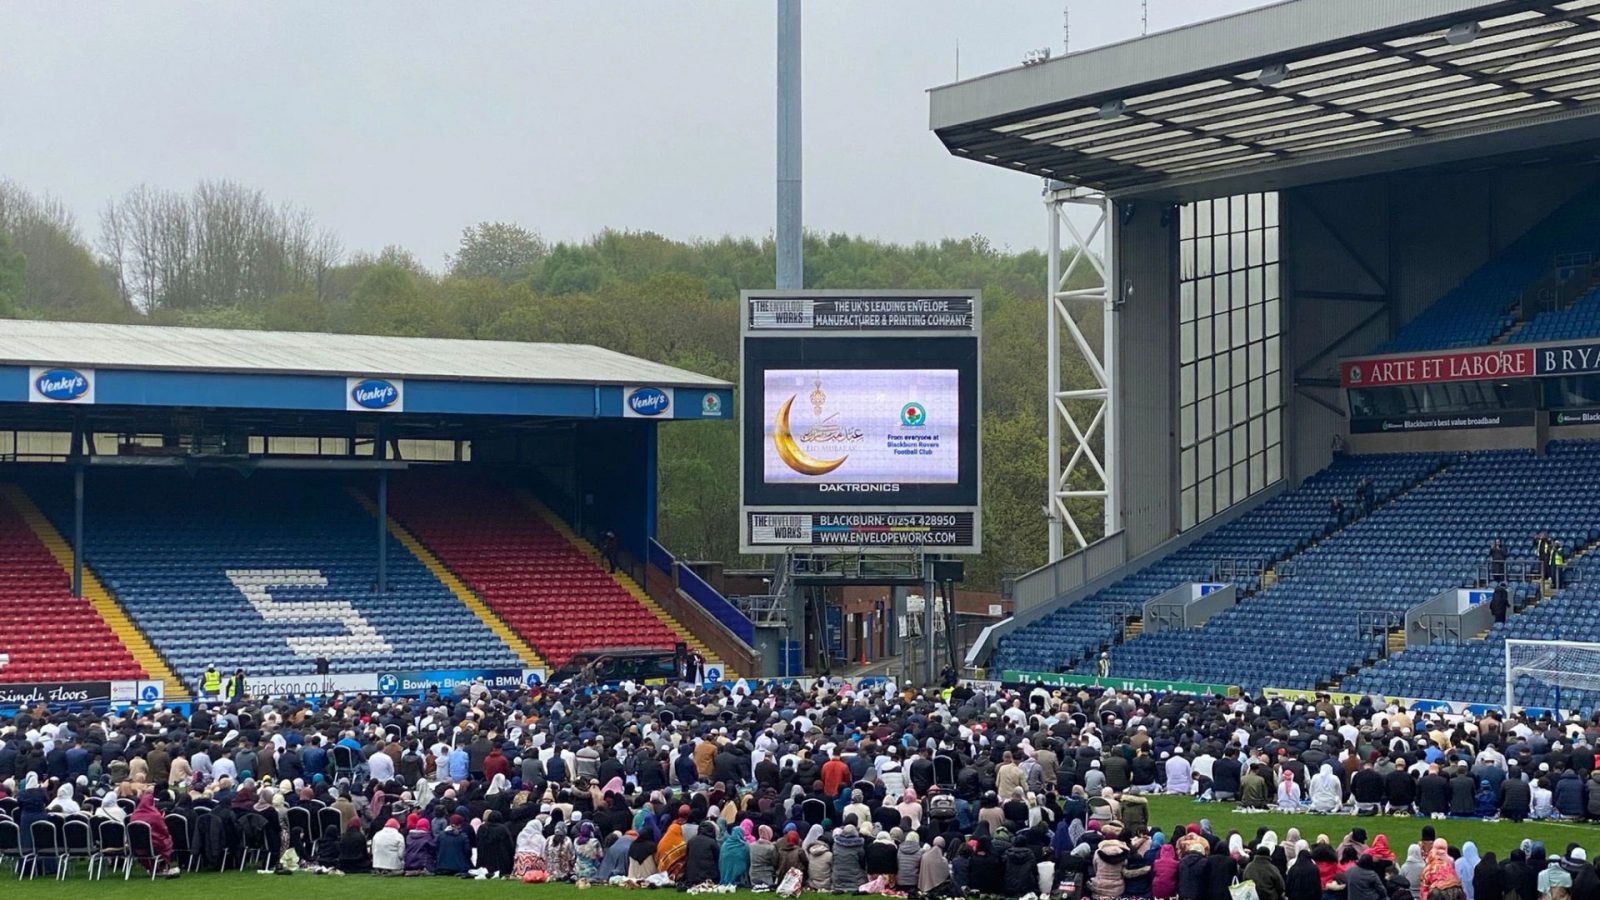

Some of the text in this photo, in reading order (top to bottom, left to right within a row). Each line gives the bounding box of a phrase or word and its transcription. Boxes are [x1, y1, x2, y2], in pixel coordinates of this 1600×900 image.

[756, 301, 769, 312] THE
[834, 301, 949, 312] THE UK'S LEADING ENVELOPE
[776, 312, 803, 324] WORKS
[816, 314, 967, 326] MANUFACTURER & PRINTING COMPANY
[1370, 352, 1526, 382] ARTE ET LABORE
[40, 377, 83, 394] Venky's
[356, 386, 393, 402] Venky's
[632, 394, 665, 409] Venky's
[1404, 420, 1437, 428] Blackburn's
[1467, 416, 1500, 424] broadband
[819, 483, 900, 492] DAKTRONICS
[754, 516, 767, 527] THE
[820, 516, 956, 525] BLACKBURN: 01254 428950
[774, 527, 802, 538] WORKS
[820, 532, 956, 543] WWW.ENVELOPEWORKS.COM
[245, 677, 336, 697] erjackson.co.uk
[443, 678, 494, 688] Blackbrn
[496, 676, 522, 686] BMW
[49, 685, 89, 700] Floors
